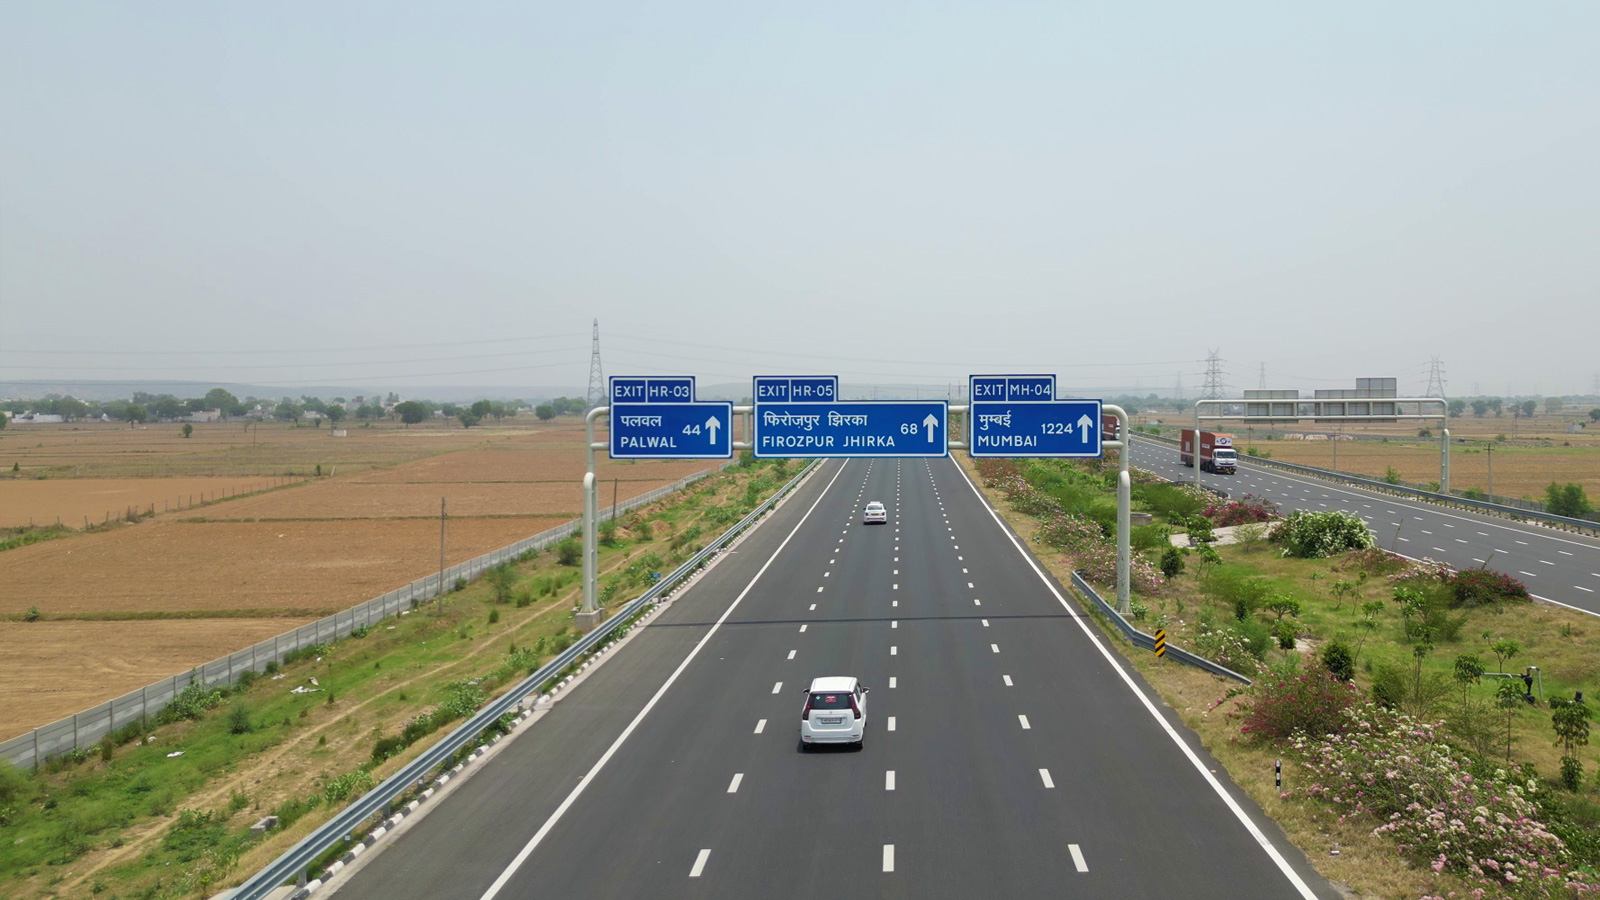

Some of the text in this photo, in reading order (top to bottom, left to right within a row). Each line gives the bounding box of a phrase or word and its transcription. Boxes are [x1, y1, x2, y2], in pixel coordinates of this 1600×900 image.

[615, 385, 689, 397] EXIT HR-03
[758, 385, 833, 397] EXIT HR-05
[975, 384, 1051, 396] EXIT MH-04
[620, 415, 662, 427] पलवल
[828, 411, 868, 427] झिरका
[978, 409, 1012, 431] मुम्बई
[682, 424, 701, 436] 44
[900, 423, 918, 435] 68
[1041, 423, 1074, 435] 1224
[620, 436, 677, 448] PALWAL
[762, 436, 895, 448] FIROZPUR JHIRKA
[978, 435, 1037, 447] MUMBAI
